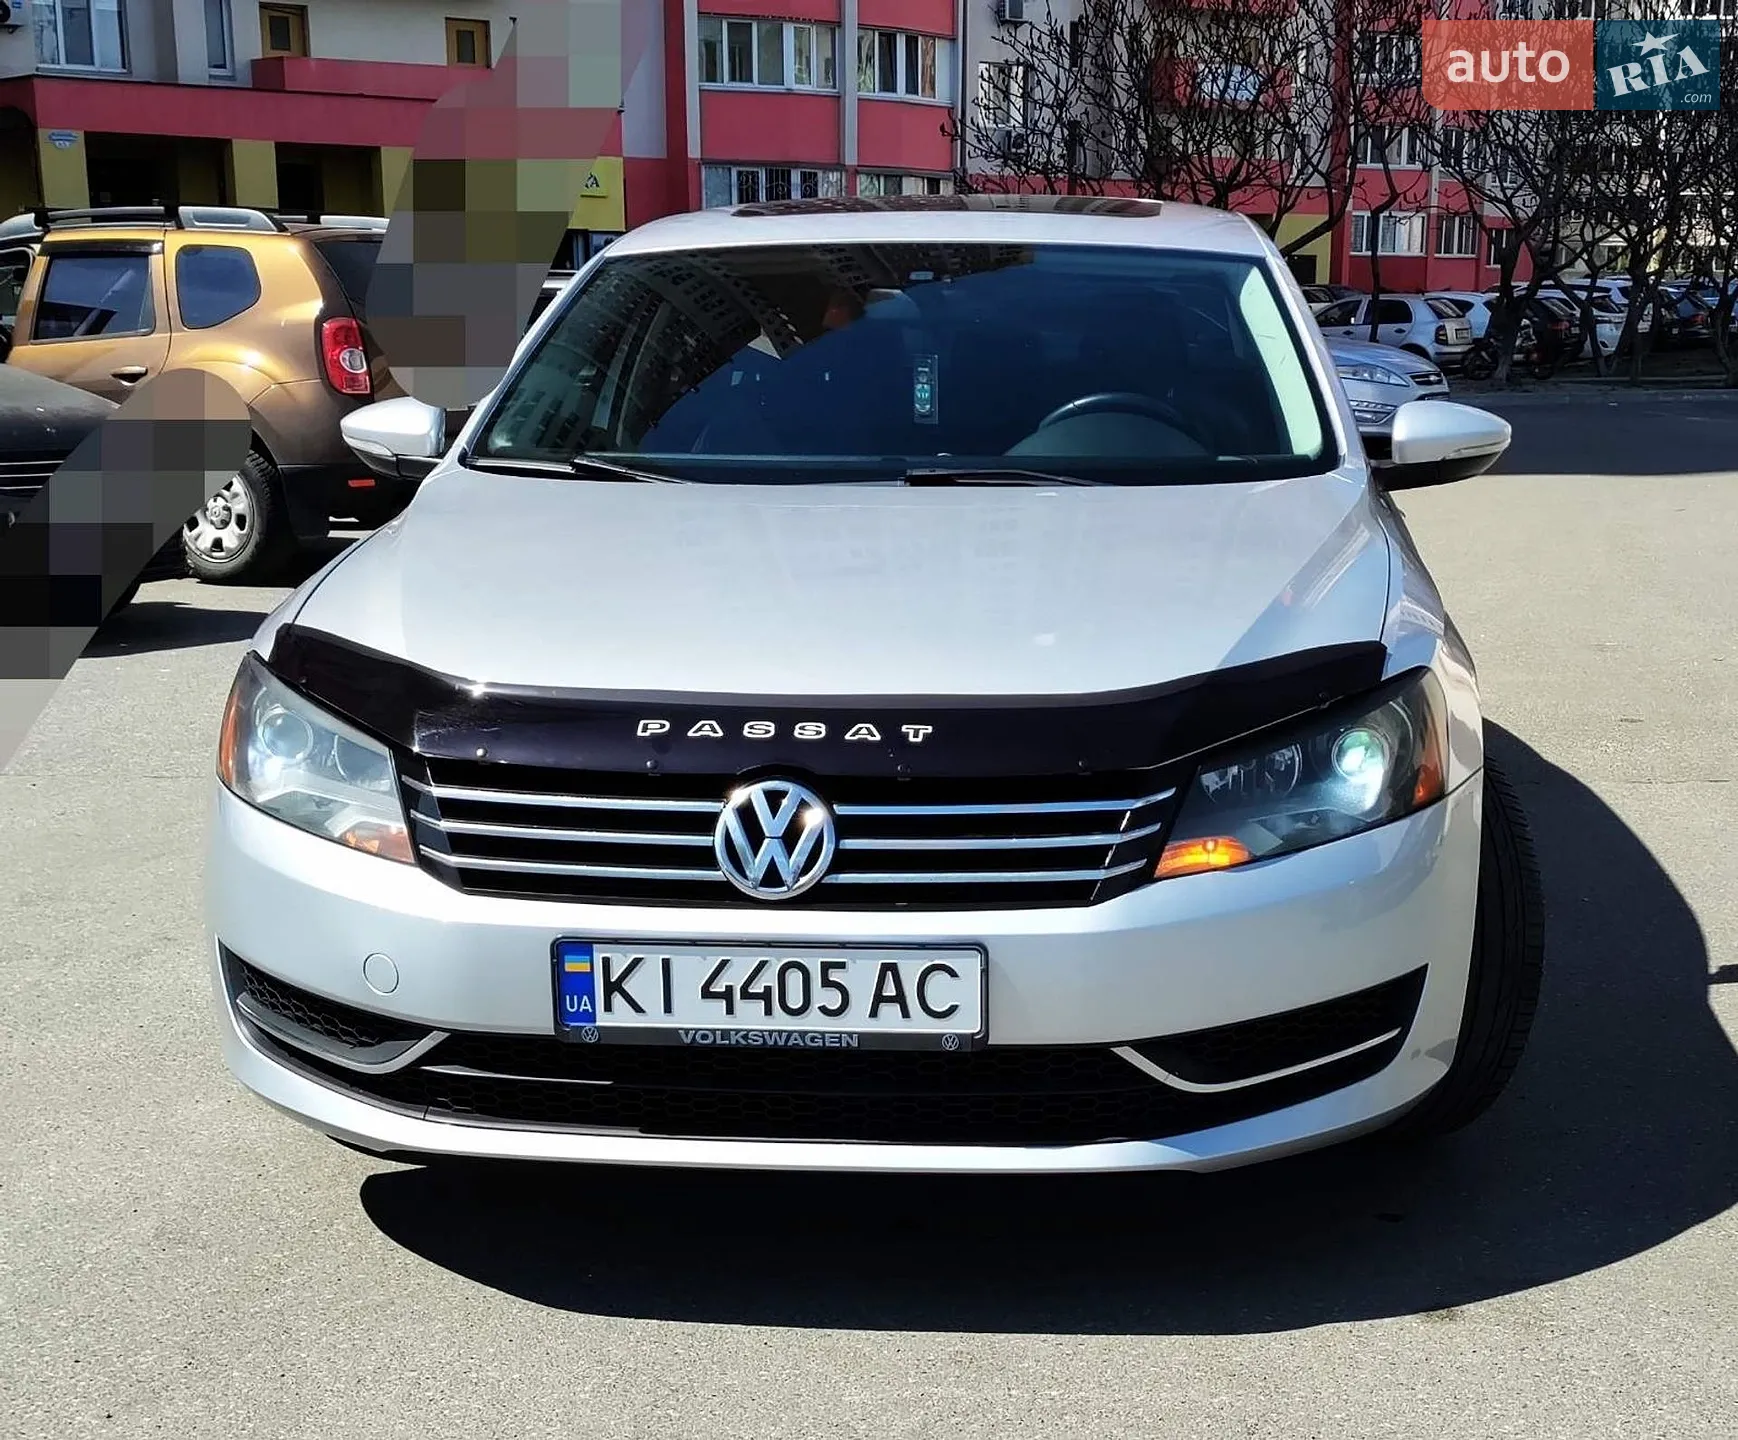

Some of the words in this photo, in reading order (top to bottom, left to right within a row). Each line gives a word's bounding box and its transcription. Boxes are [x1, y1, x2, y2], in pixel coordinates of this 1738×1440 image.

[636, 719, 933, 743] PASSAT
[602, 957, 673, 1015] KI
[700, 959, 850, 1018] 4405
[868, 961, 961, 1020] AC
[565, 994, 593, 1013] UA
[678, 1029, 859, 1048] VOLKSWAGEN
